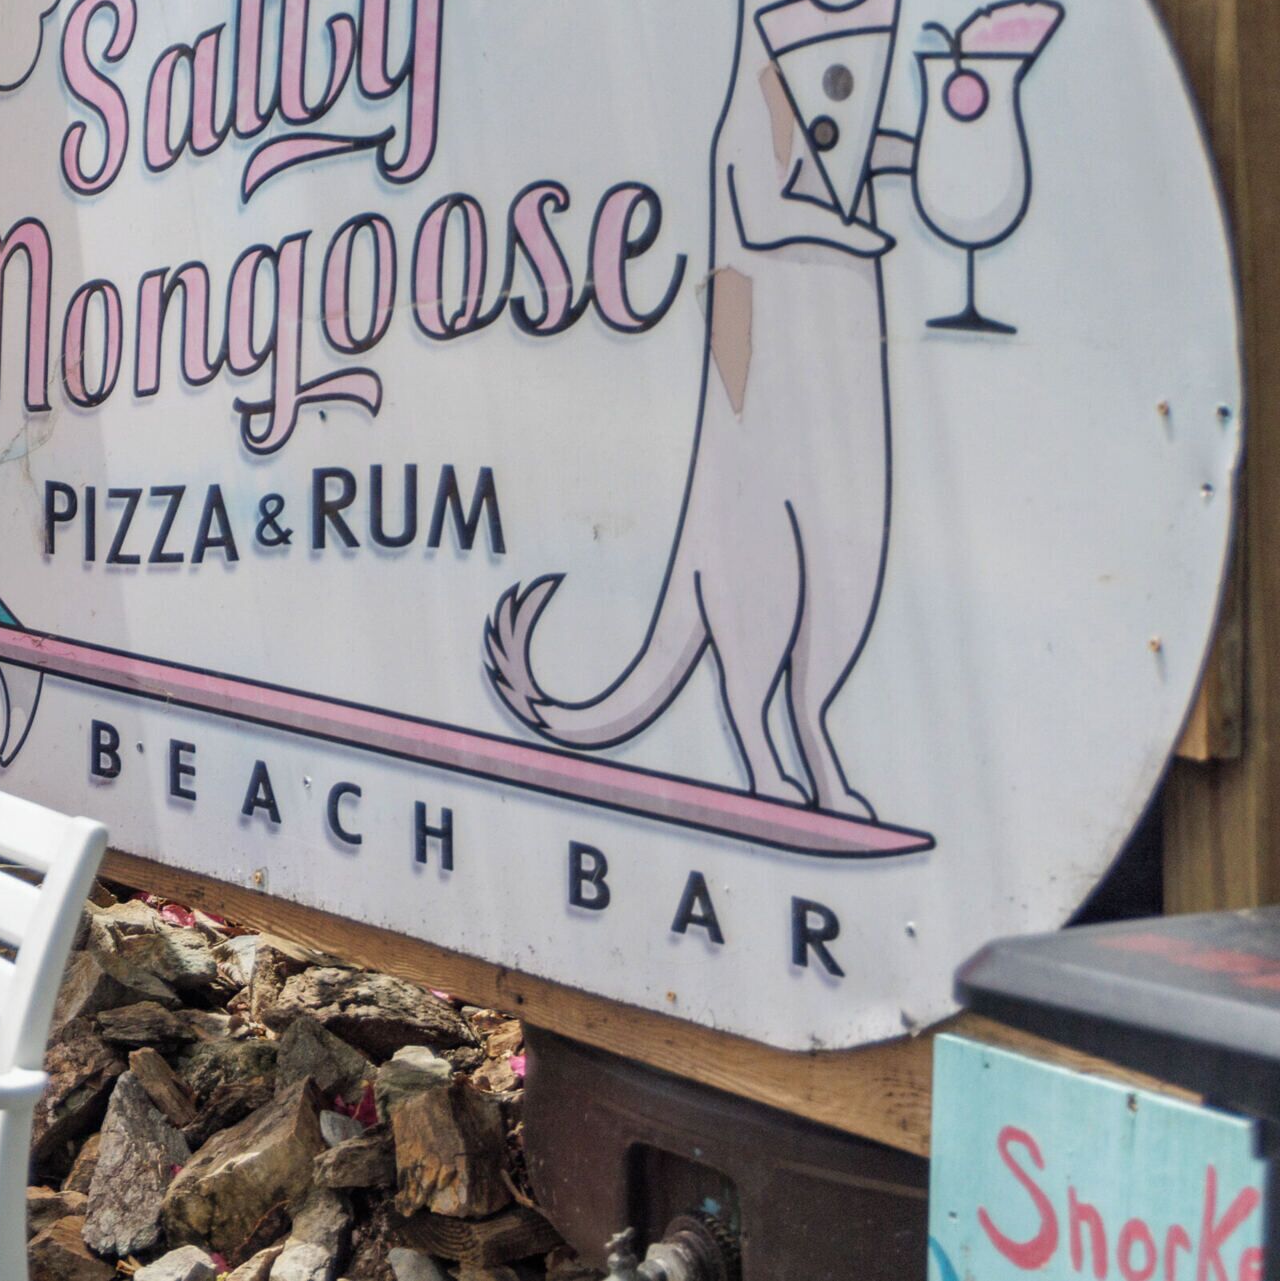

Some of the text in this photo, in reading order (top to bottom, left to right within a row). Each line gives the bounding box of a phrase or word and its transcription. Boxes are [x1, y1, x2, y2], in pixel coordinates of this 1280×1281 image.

[44, 482, 240, 565] PIZZA
[311, 463, 506, 556] RUM
[89, 719, 846, 978] BEACH BAR
